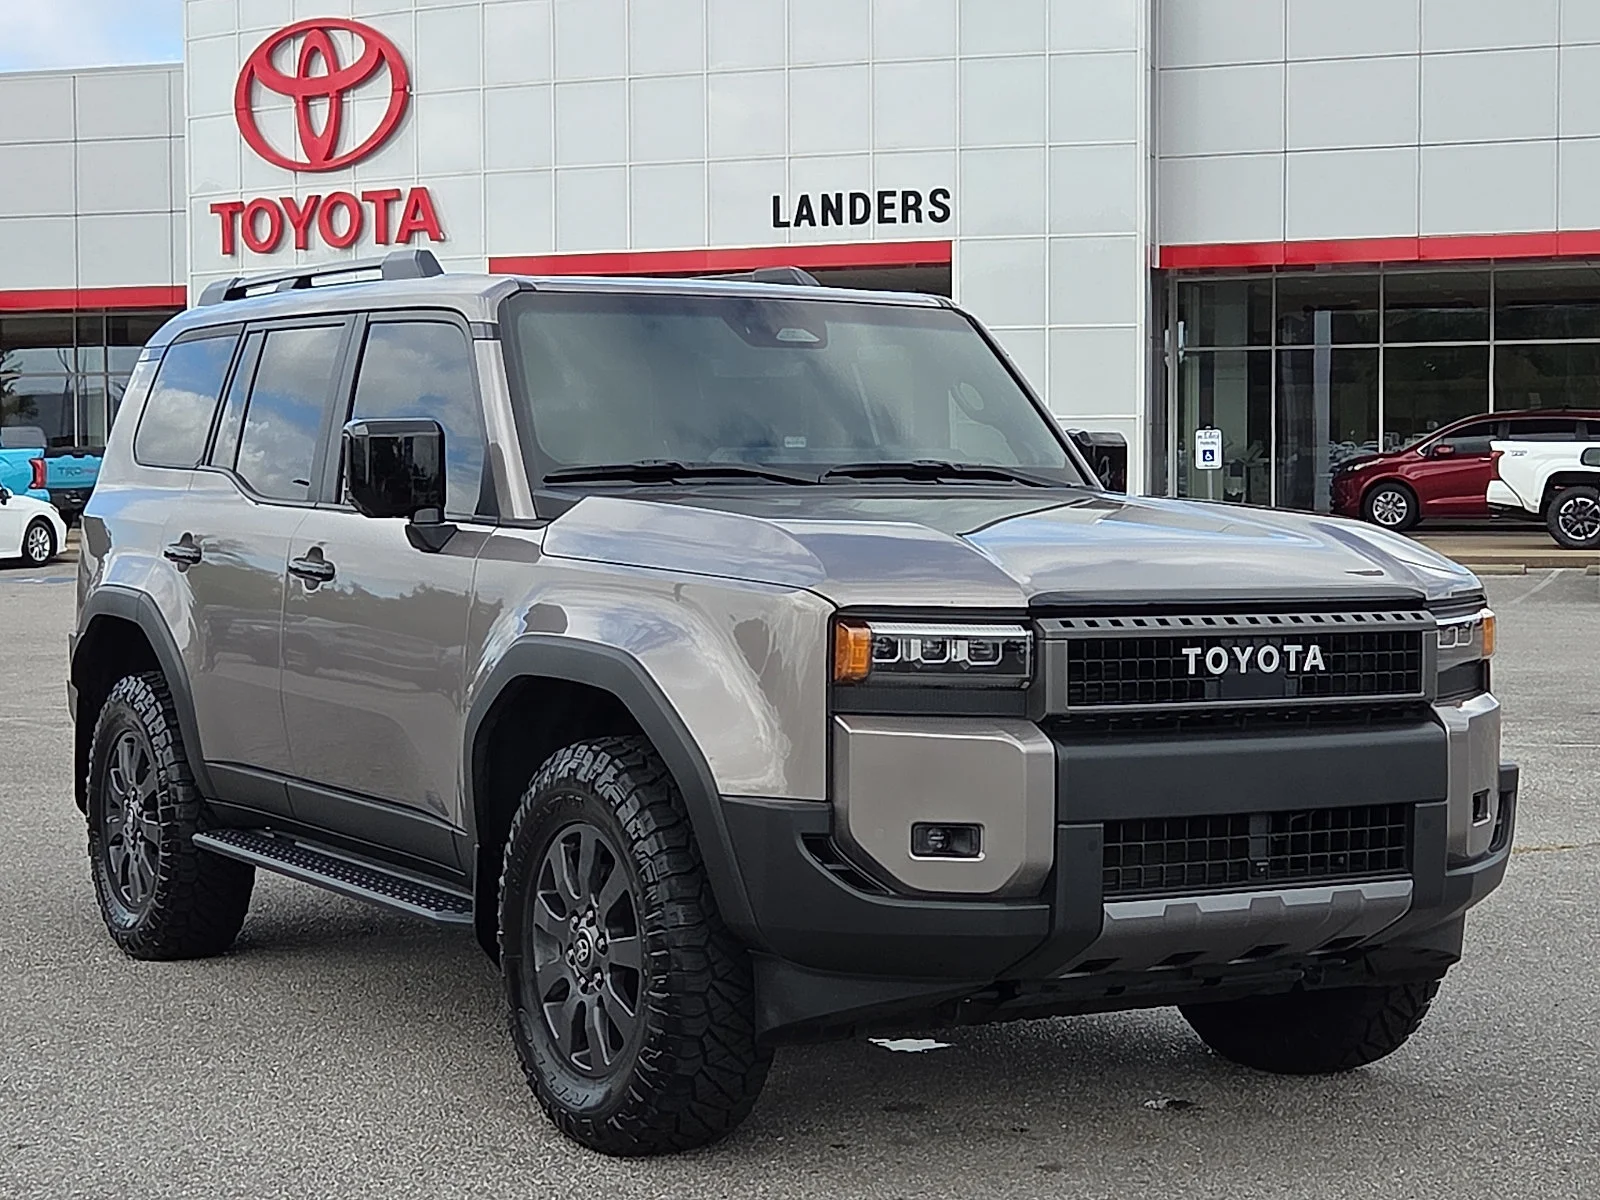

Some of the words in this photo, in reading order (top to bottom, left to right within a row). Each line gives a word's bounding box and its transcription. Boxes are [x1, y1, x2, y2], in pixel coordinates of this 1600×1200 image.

[210, 187, 446, 255] TOYOTA
[772, 188, 951, 228] LANDERS
[1181, 644, 1326, 675] TOYOTA
